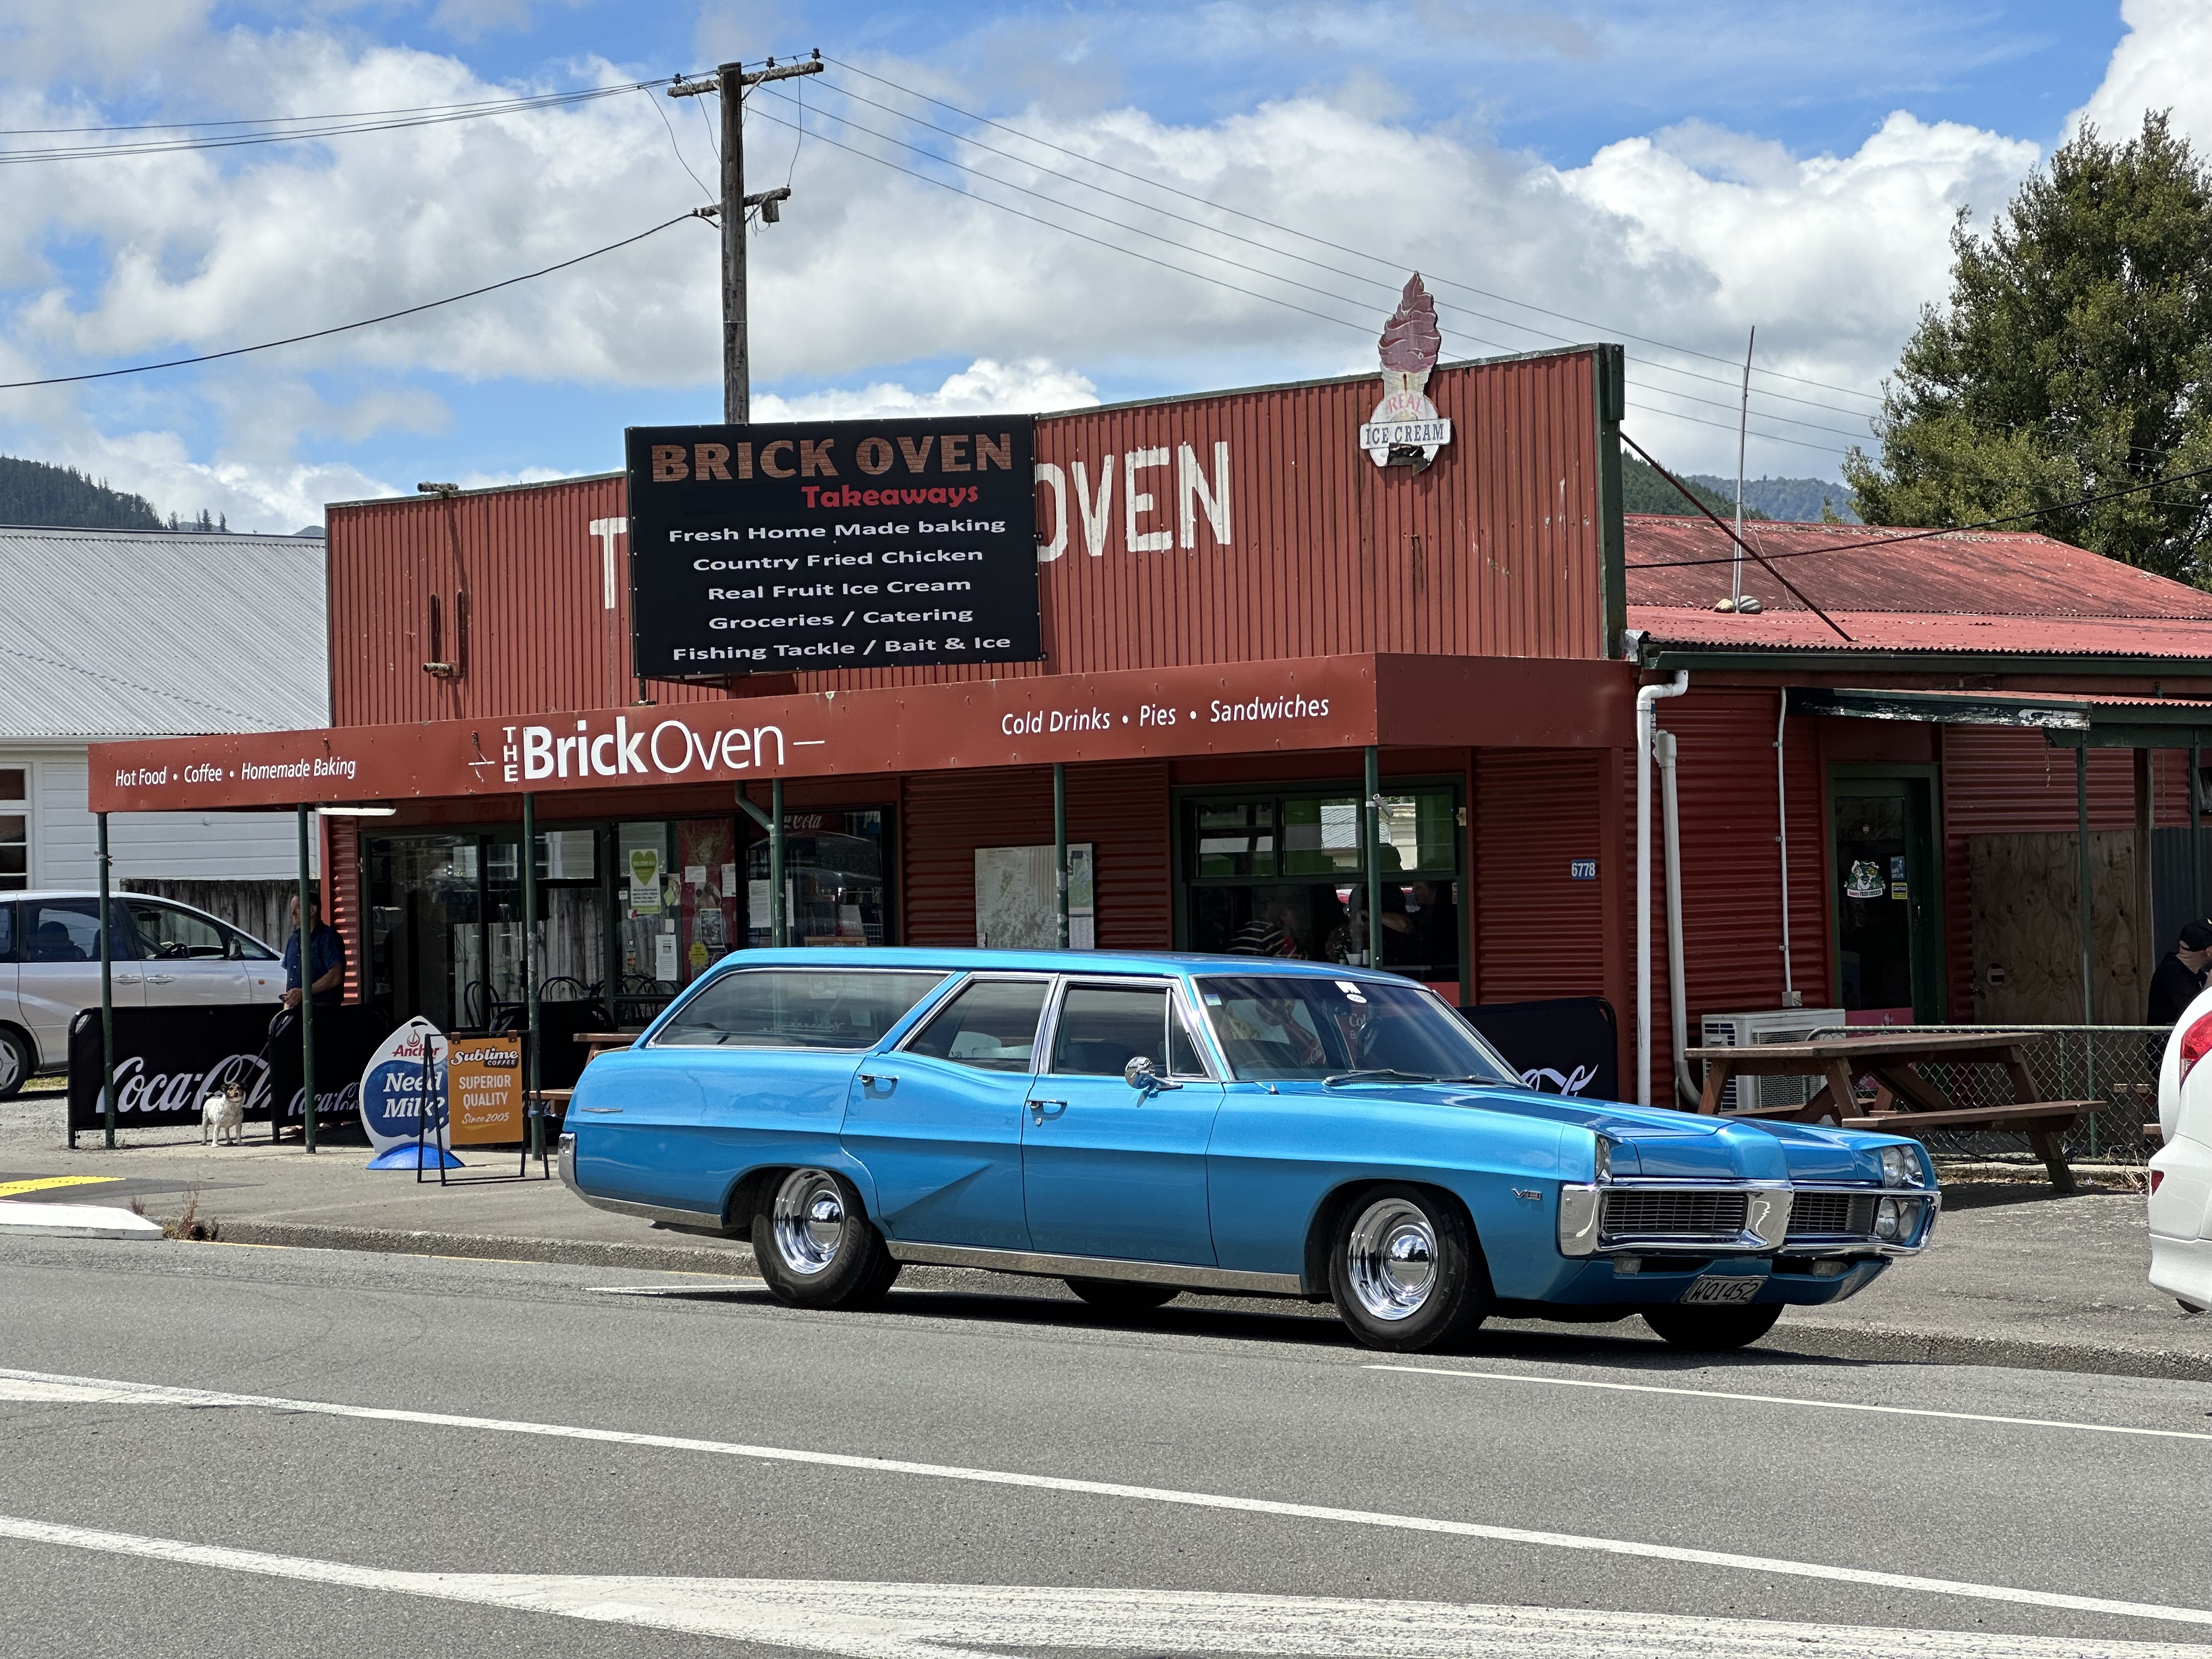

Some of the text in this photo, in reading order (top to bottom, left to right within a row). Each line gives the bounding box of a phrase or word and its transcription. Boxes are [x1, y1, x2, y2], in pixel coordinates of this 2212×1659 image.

[1388, 393, 1422, 413] REAL
[1366, 424, 1444, 445] ICE CREAM
[652, 433, 1012, 482] BRICK OVEN
[802, 485, 977, 507] Takeaways
[670, 520, 1005, 541] Fresh Home Made baking
[693, 550, 982, 570] Country Fried Chicken
[709, 582, 970, 600] Real Fruit Ice Cream
[709, 614, 833, 629] Groceries
[864, 609, 973, 623] Catering
[674, 647, 766, 660] Fishing
[774, 642, 854, 656] Tackle
[886, 639, 936, 652] Bait
[945, 638, 966, 649] &
[975, 637, 1010, 648] Ice
[1002, 694, 1328, 735] Cold Drinks Pies Sandwiches
[503, 726, 518, 782] THE
[116, 757, 356, 786] Hot Food Coffee Homemade Baking
[1571, 862, 1595, 877] 6778
[392, 1045, 440, 1057] Anchr
[450, 1047, 518, 1065] Sublime
[384, 1071, 442, 1092] Need
[459, 1075, 511, 1090] SUPERIOR
[383, 1097, 445, 1118] Milk?
[462, 1092, 508, 1109] QUALITY
[462, 1113, 510, 1125] Since 2005
[1511, 1188, 1541, 1200] V8
[1690, 1282, 1759, 1301] WQ1452
